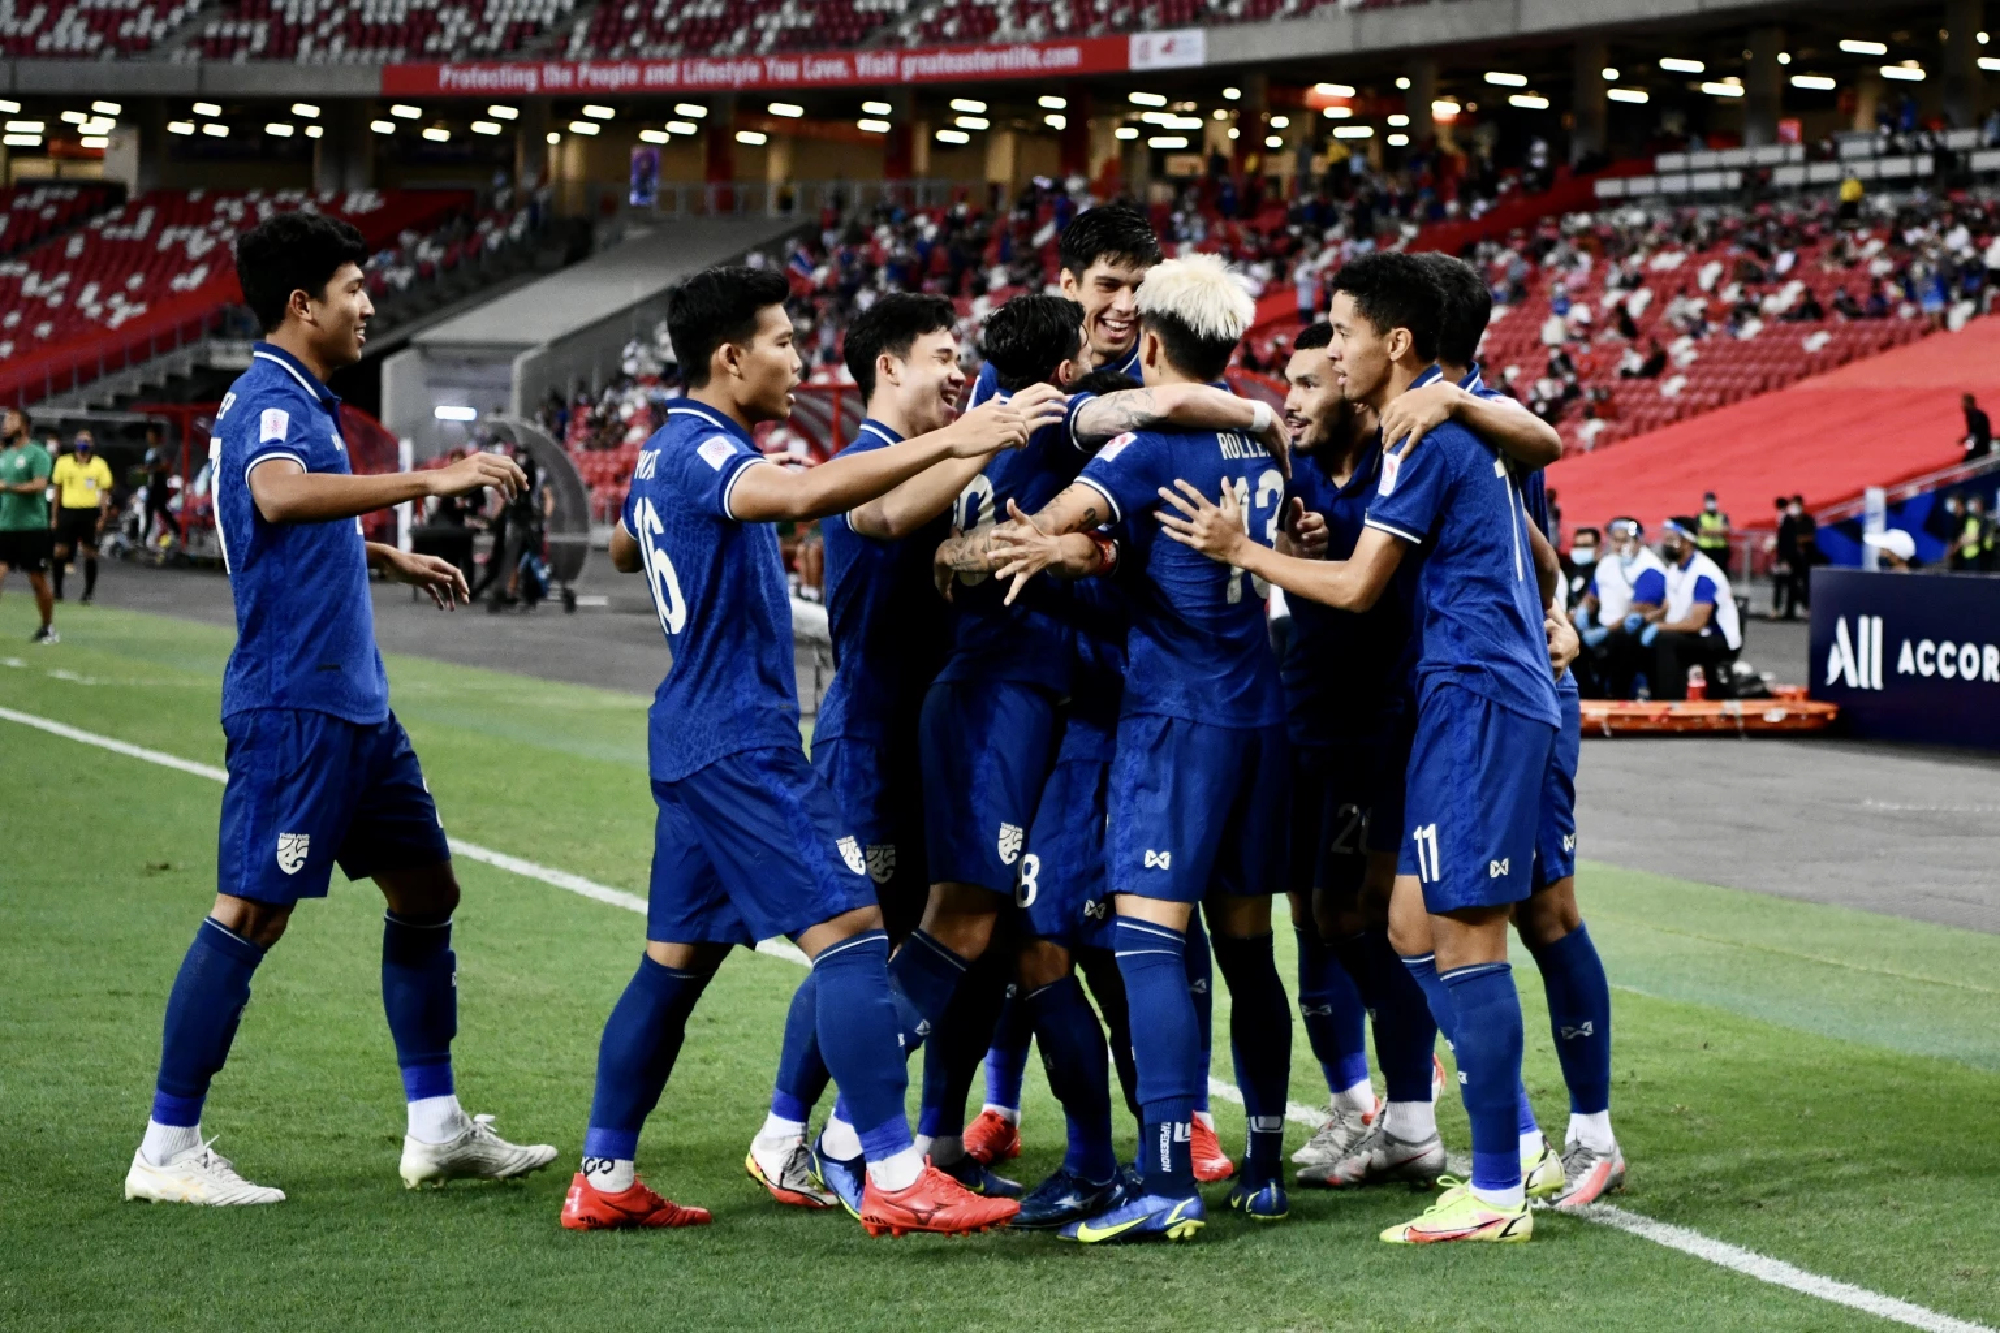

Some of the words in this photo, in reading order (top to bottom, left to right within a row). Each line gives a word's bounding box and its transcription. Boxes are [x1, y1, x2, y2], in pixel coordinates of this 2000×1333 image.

[439, 64, 536, 91] Protecting
[543, 64, 572, 87] the
[578, 62, 638, 90] People
[644, 63, 678, 86] and
[765, 56, 798, 82] You
[1216, 432, 1271, 461] ROLLE
[633, 496, 687, 635] 16
[1897, 638, 2000, 683] ACCOR
[1413, 823, 1440, 884] 11
